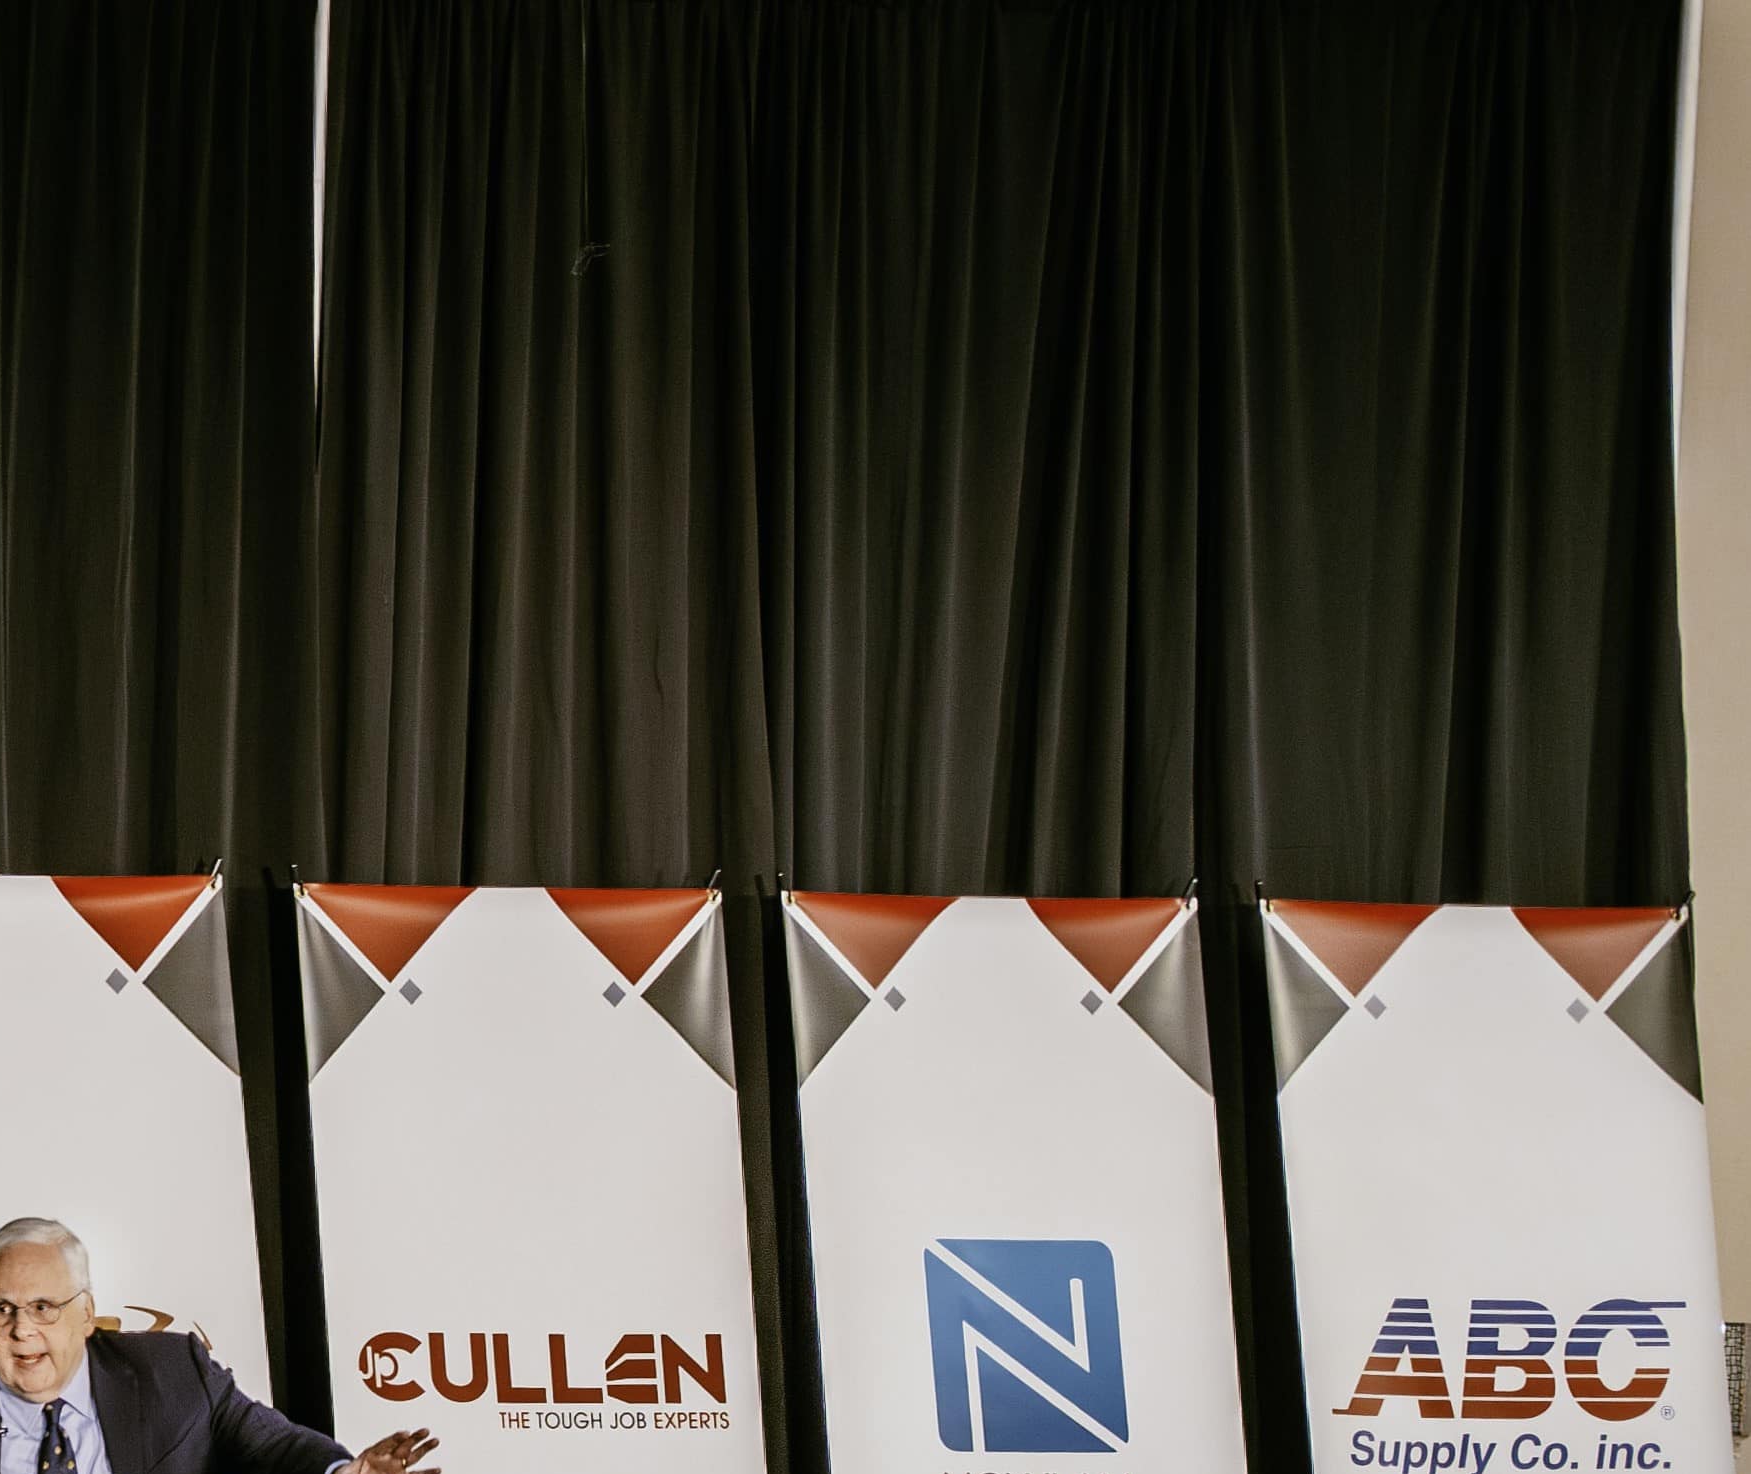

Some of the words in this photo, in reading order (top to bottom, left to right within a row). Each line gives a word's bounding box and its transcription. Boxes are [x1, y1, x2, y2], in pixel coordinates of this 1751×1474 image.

[357, 1330, 728, 1405] CULLEN
[1331, 1297, 1688, 1422] ABC
[498, 1411, 531, 1430] THE
[535, 1411, 603, 1430] TOUGH
[609, 1411, 647, 1430] JOB
[653, 1411, 730, 1430] EXPERTS
[1510, 1433, 1579, 1471] Co.
[1595, 1434, 1671, 1470] inc.
